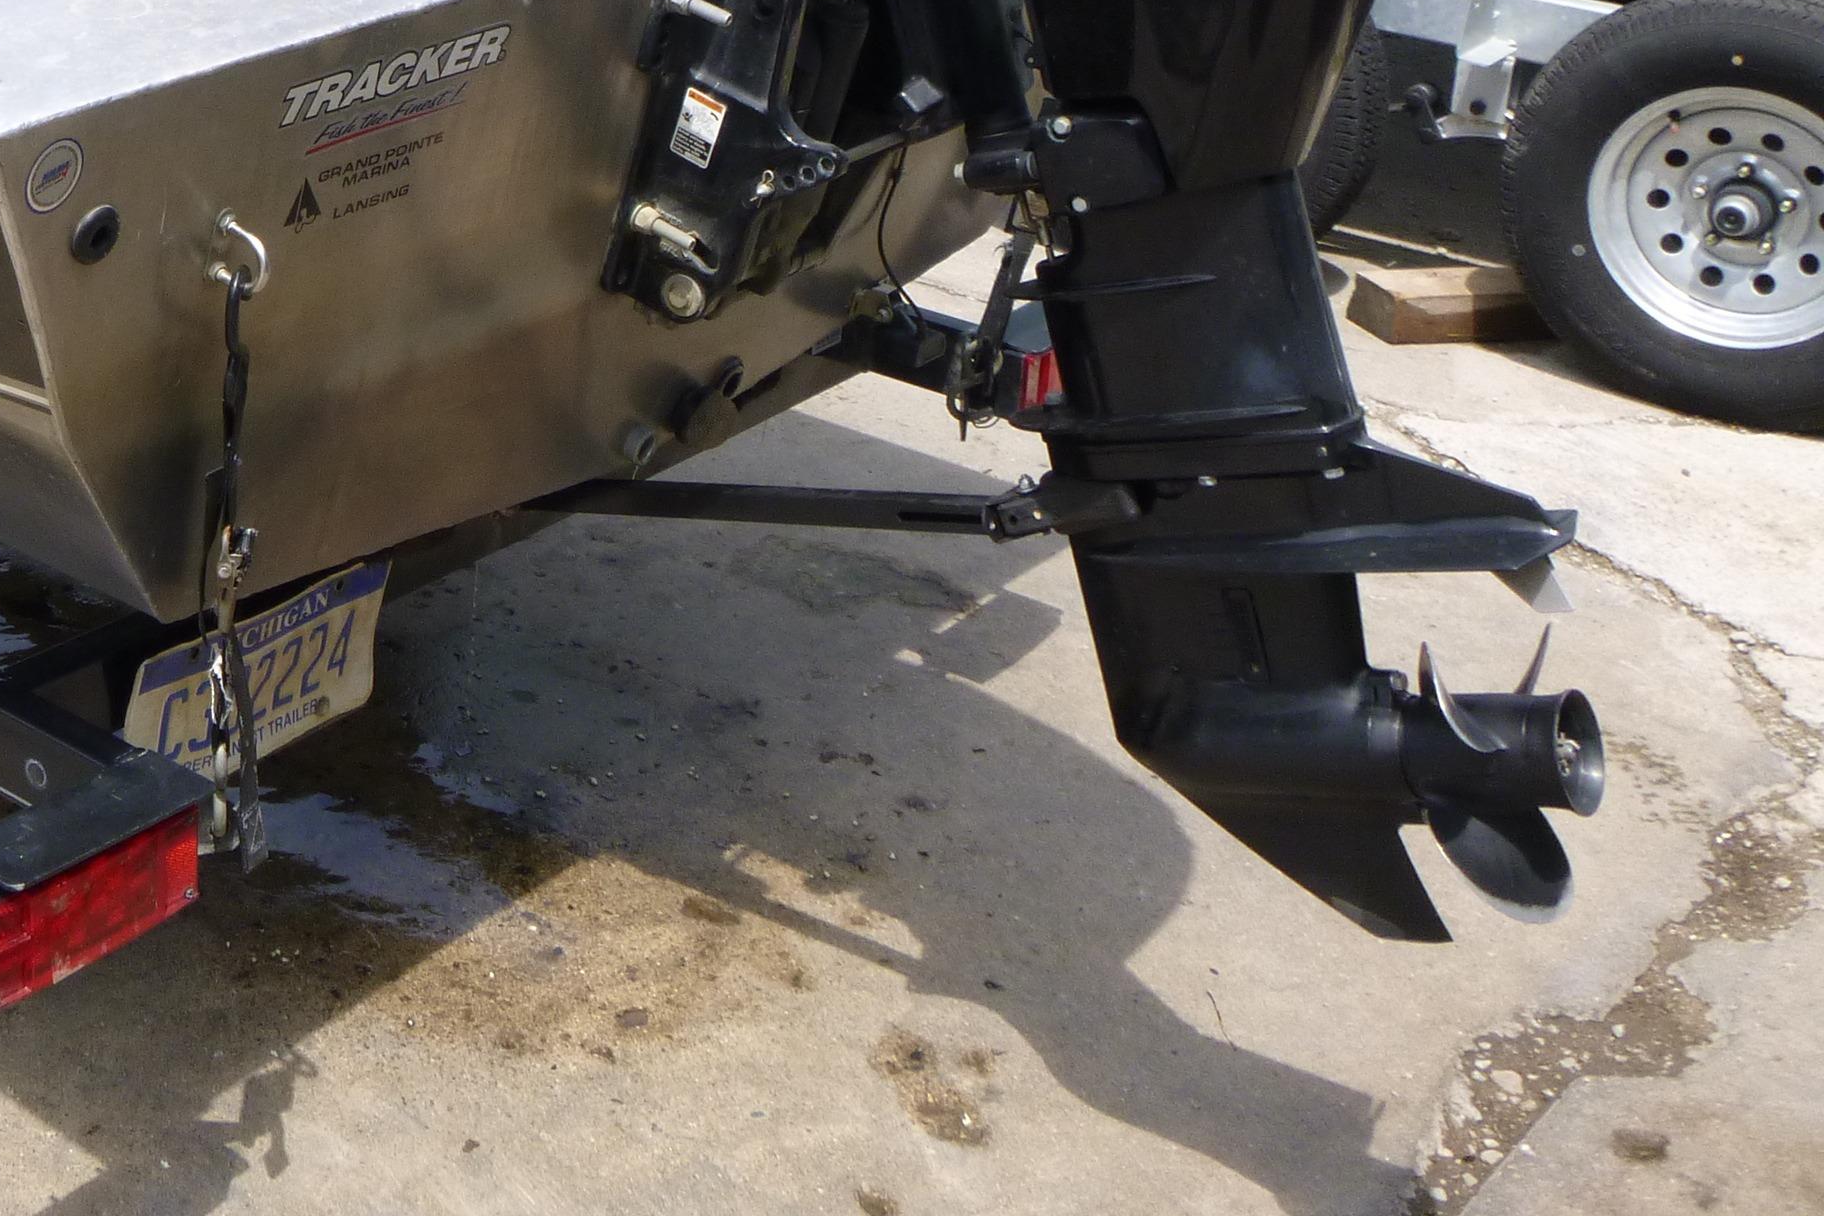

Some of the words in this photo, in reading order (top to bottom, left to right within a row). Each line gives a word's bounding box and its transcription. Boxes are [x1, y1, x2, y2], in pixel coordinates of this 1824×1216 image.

[279, 24, 512, 128] TRACKER
[360, 109, 389, 129] the
[318, 153, 381, 183] GRAND
[384, 132, 444, 162] POINTE
[342, 156, 411, 188] MARINA
[333, 184, 410, 219] LANSING
[209, 588, 330, 664] CHIGAN
